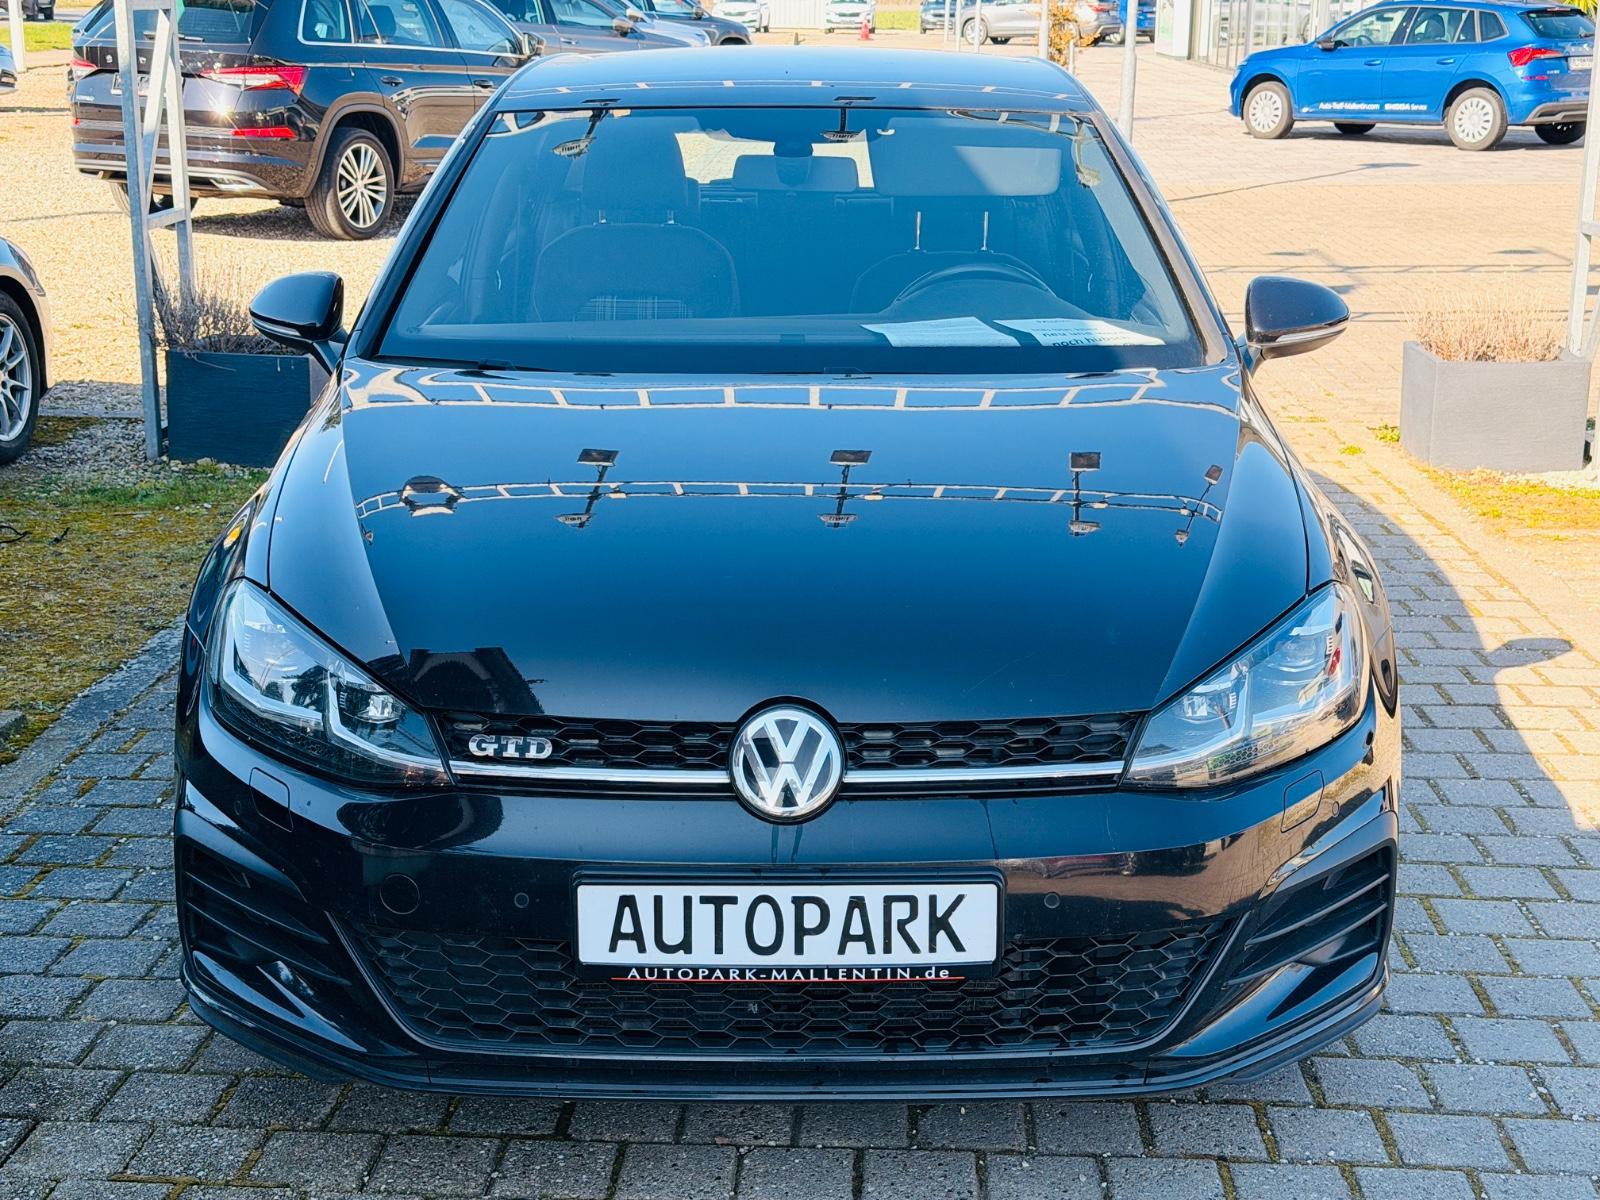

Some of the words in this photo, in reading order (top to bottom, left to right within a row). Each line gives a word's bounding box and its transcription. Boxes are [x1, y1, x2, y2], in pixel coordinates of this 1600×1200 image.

[468, 734, 553, 759] GTD
[740, 709, 837, 814] VW
[608, 893, 968, 956] AUTOPARK
[626, 966, 951, 981] AUTOPARK-MALLENTIN.de
